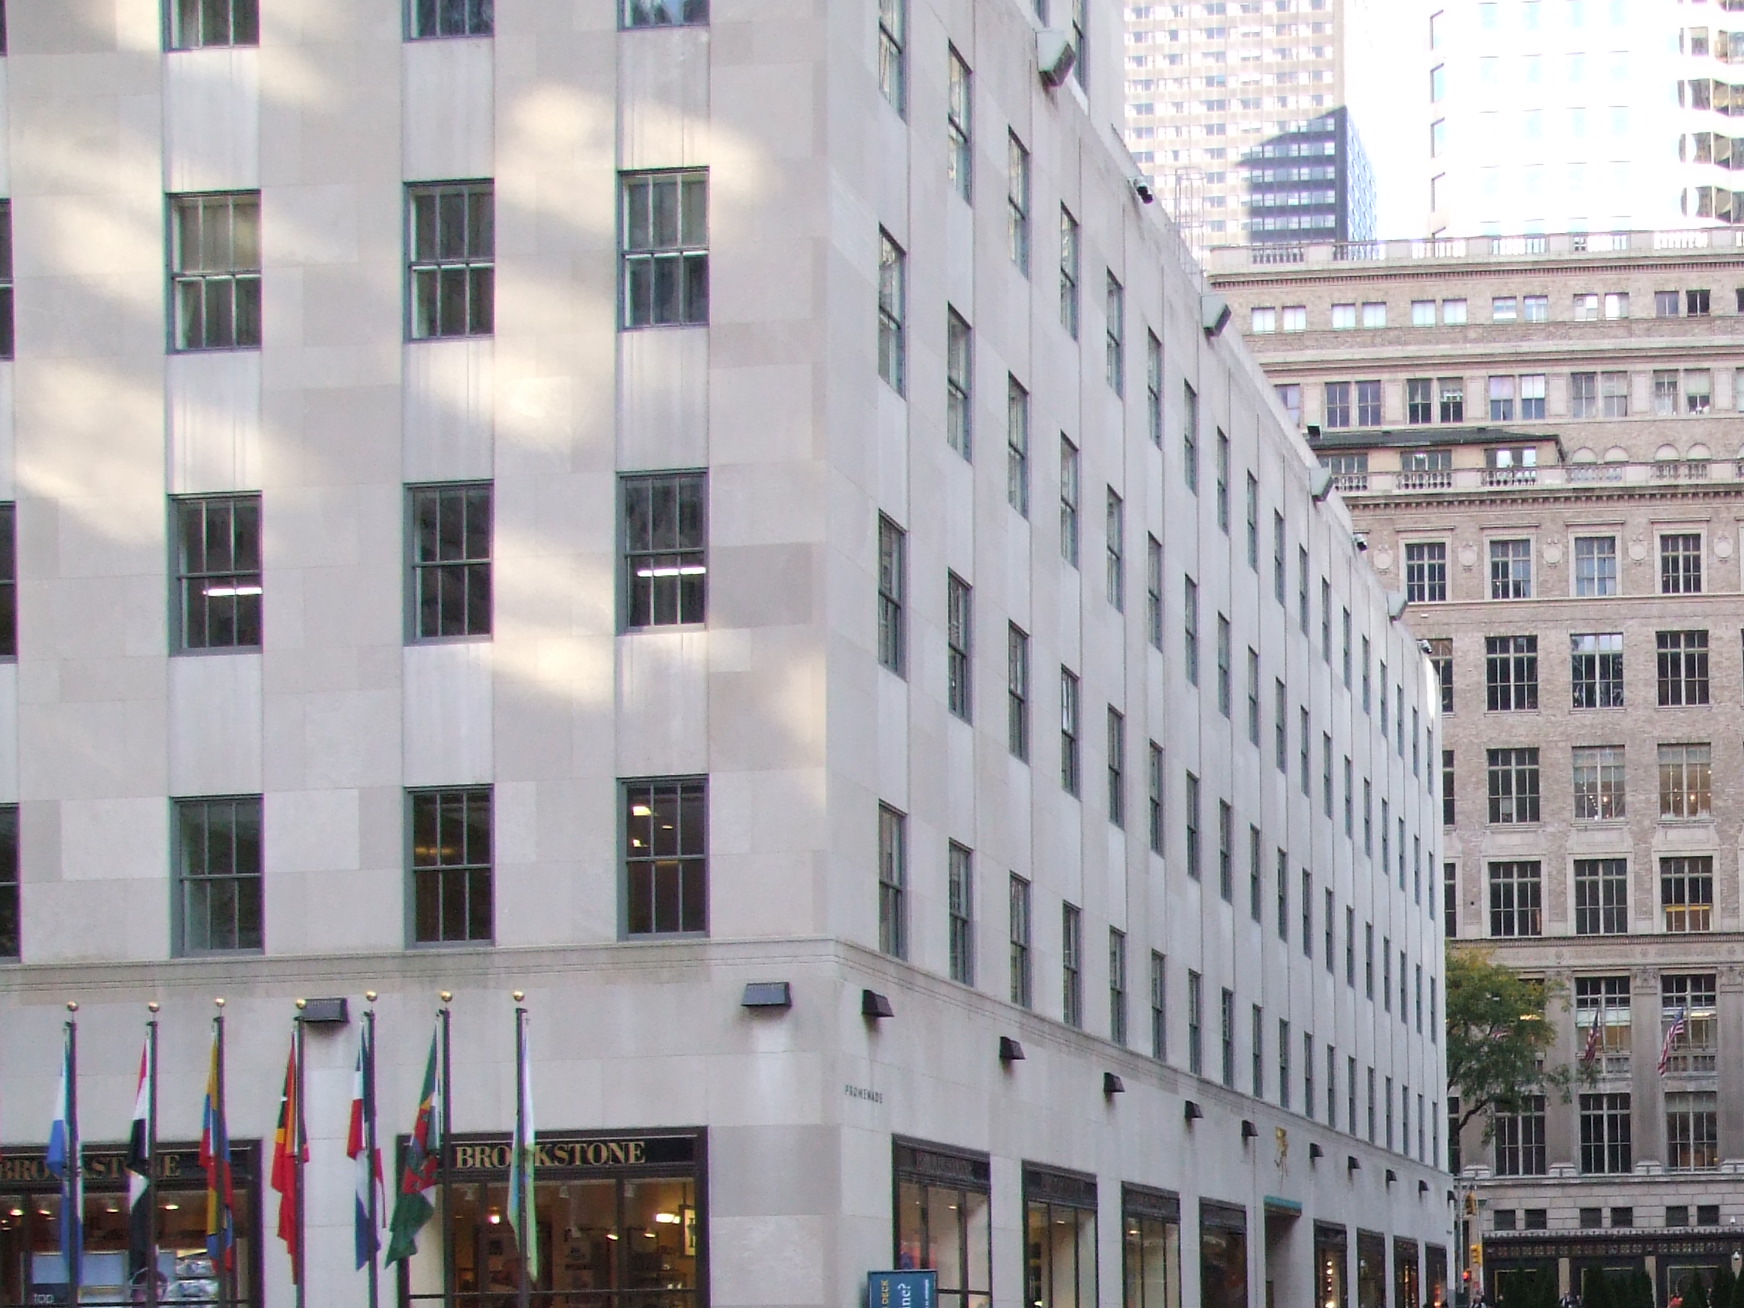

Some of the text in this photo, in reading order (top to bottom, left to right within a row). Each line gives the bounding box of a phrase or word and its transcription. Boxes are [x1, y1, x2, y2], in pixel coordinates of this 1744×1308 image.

[0, 1154, 181, 1181] BROSTE
[456, 1141, 645, 1169] BROKSTONE
[34, 1294, 54, 1304] top
